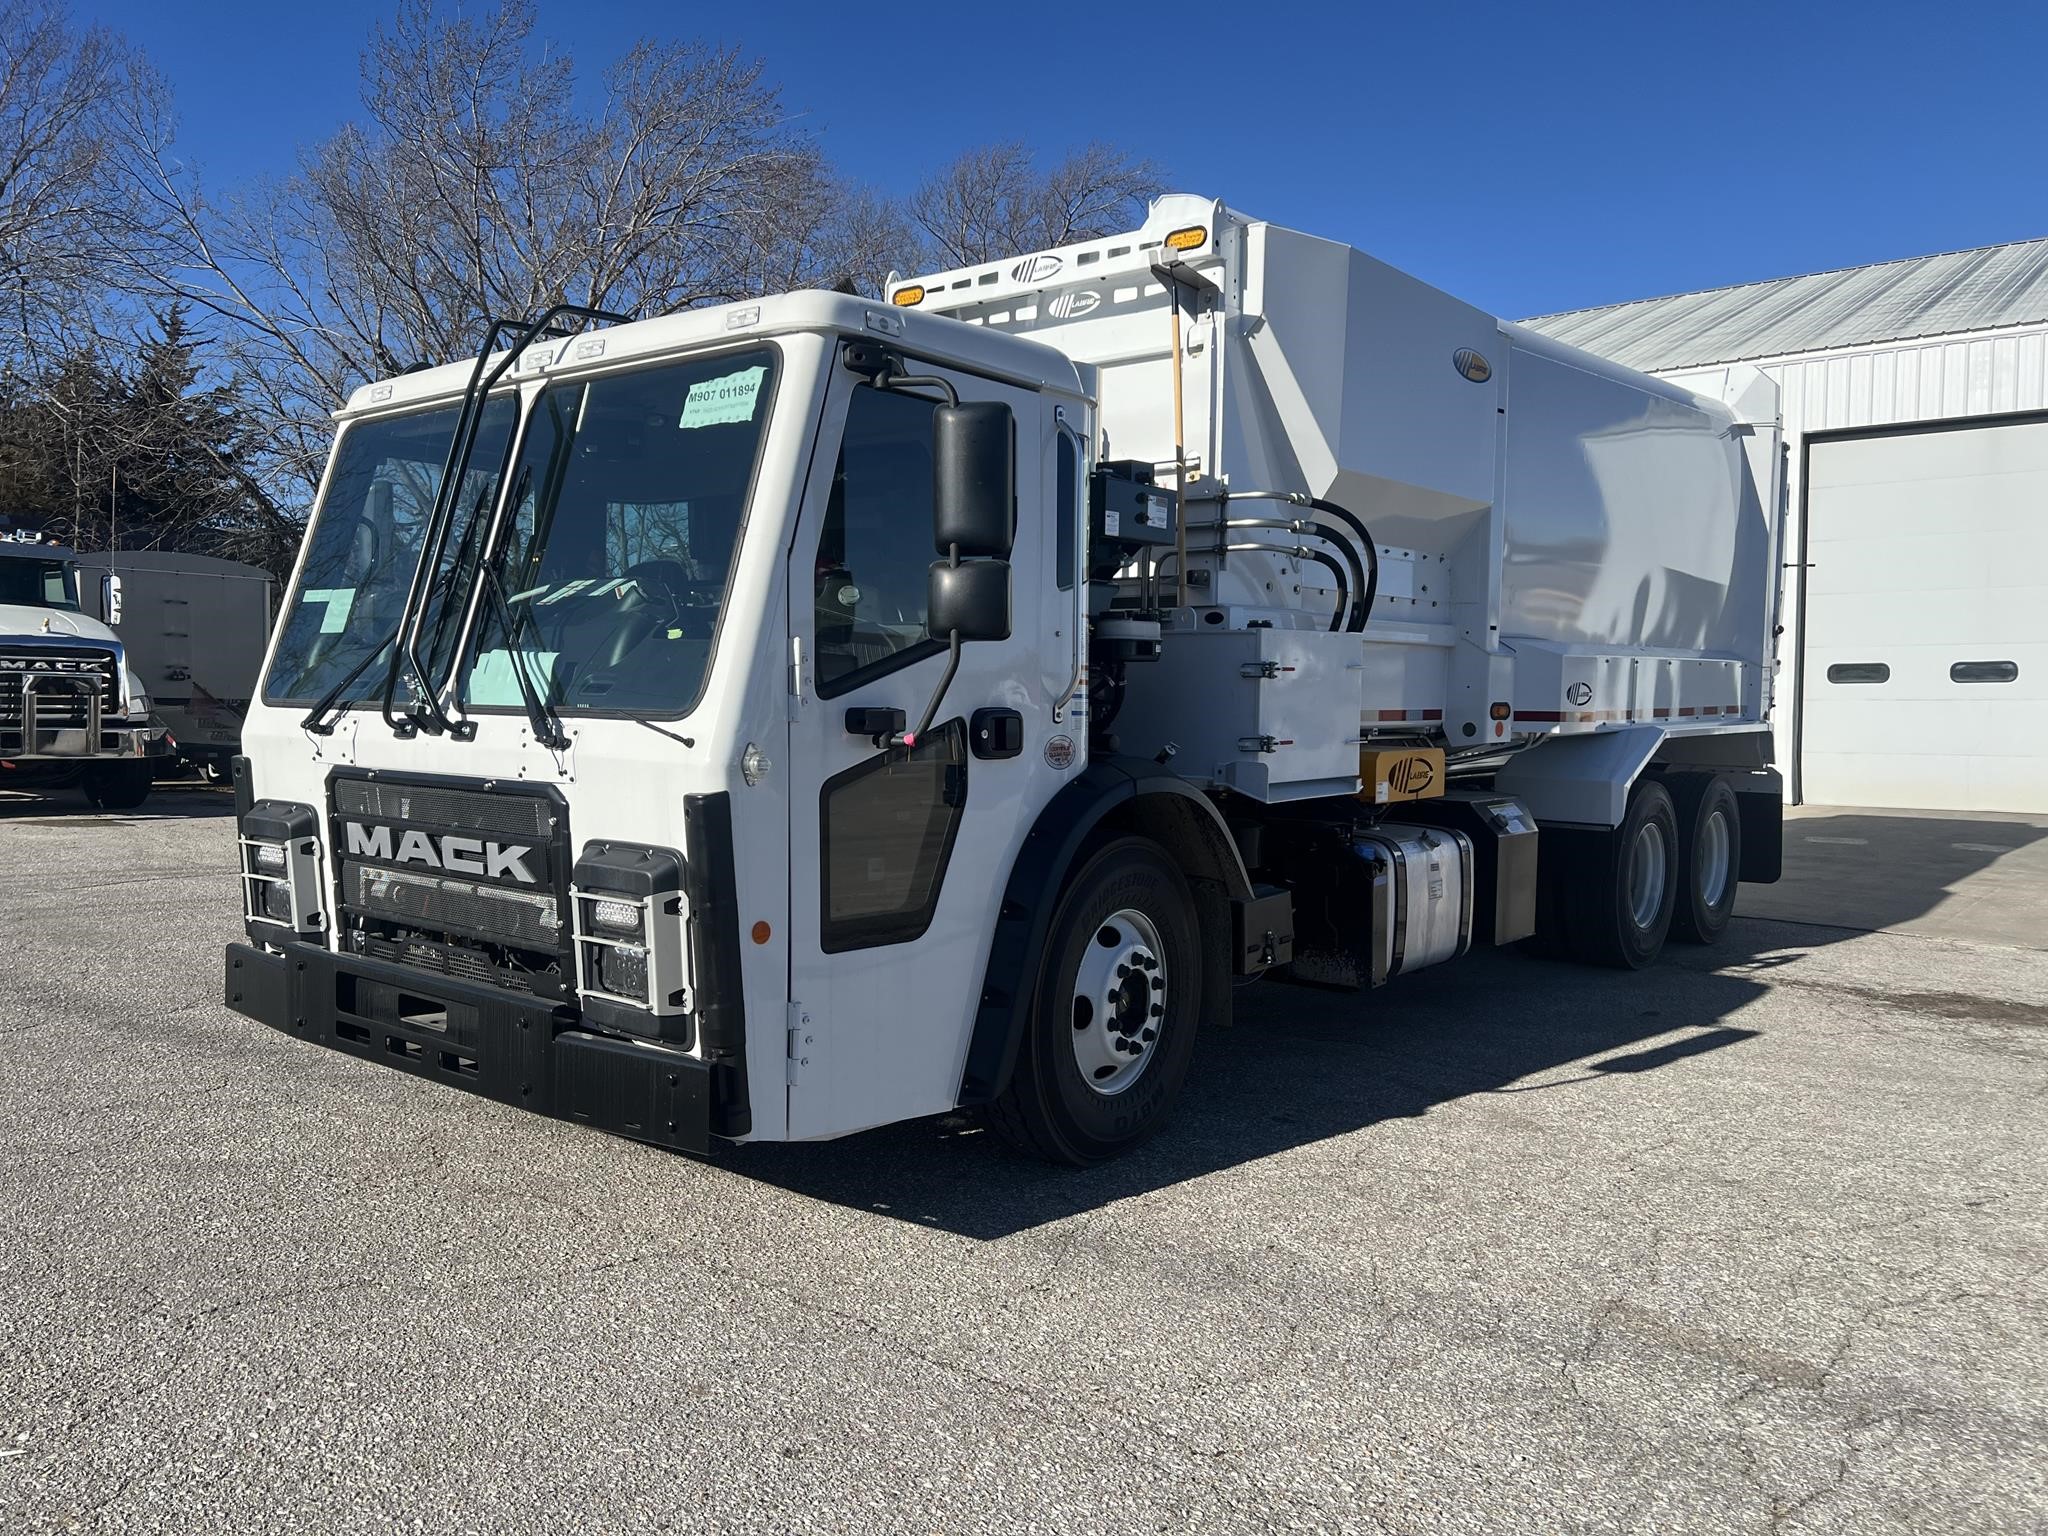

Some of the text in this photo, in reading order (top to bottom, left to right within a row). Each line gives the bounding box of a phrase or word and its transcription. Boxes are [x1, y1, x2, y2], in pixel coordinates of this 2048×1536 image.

[719, 382, 756, 399] 011894
[0, 660, 103, 672] MACK
[346, 821, 538, 884] MACK
